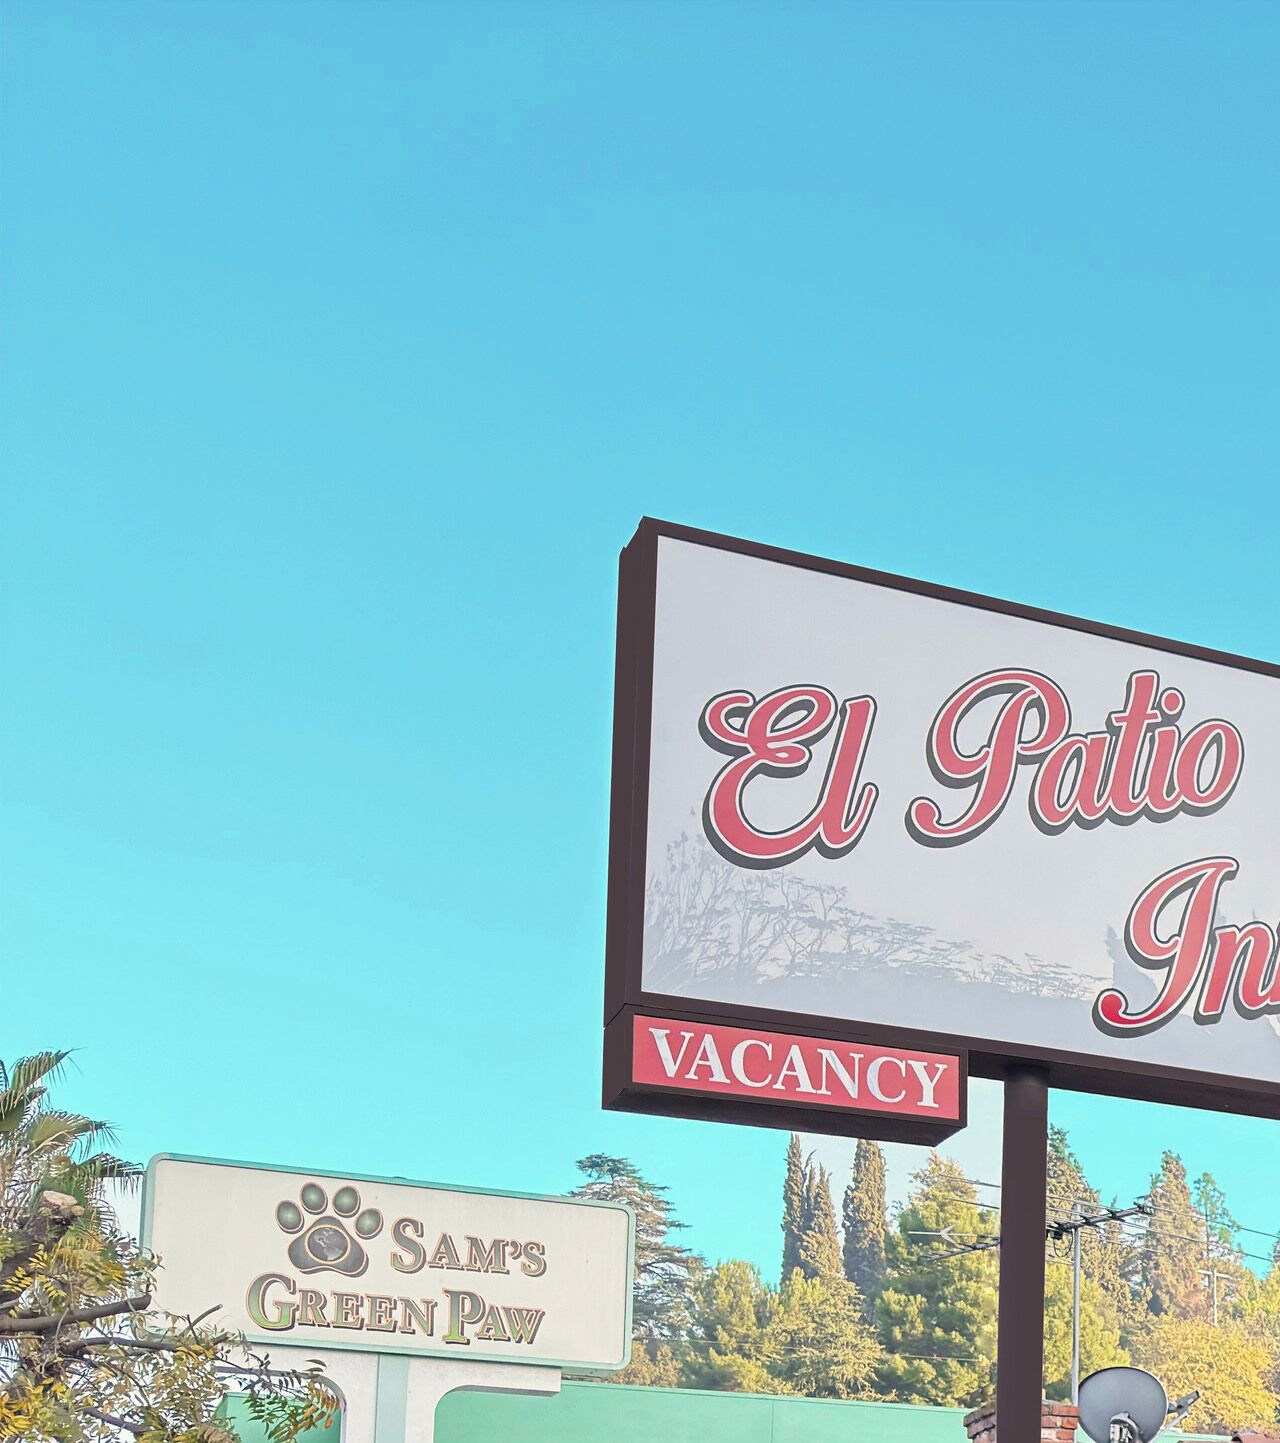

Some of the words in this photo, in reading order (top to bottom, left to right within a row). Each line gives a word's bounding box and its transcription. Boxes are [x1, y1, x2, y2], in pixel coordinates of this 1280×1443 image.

[700, 683, 879, 869] El
[905, 667, 1244, 848] Patio
[648, 1027, 948, 1108] VACANCY
[246, 1271, 438, 1336] GREEN
[442, 1287, 546, 1346] PAW
